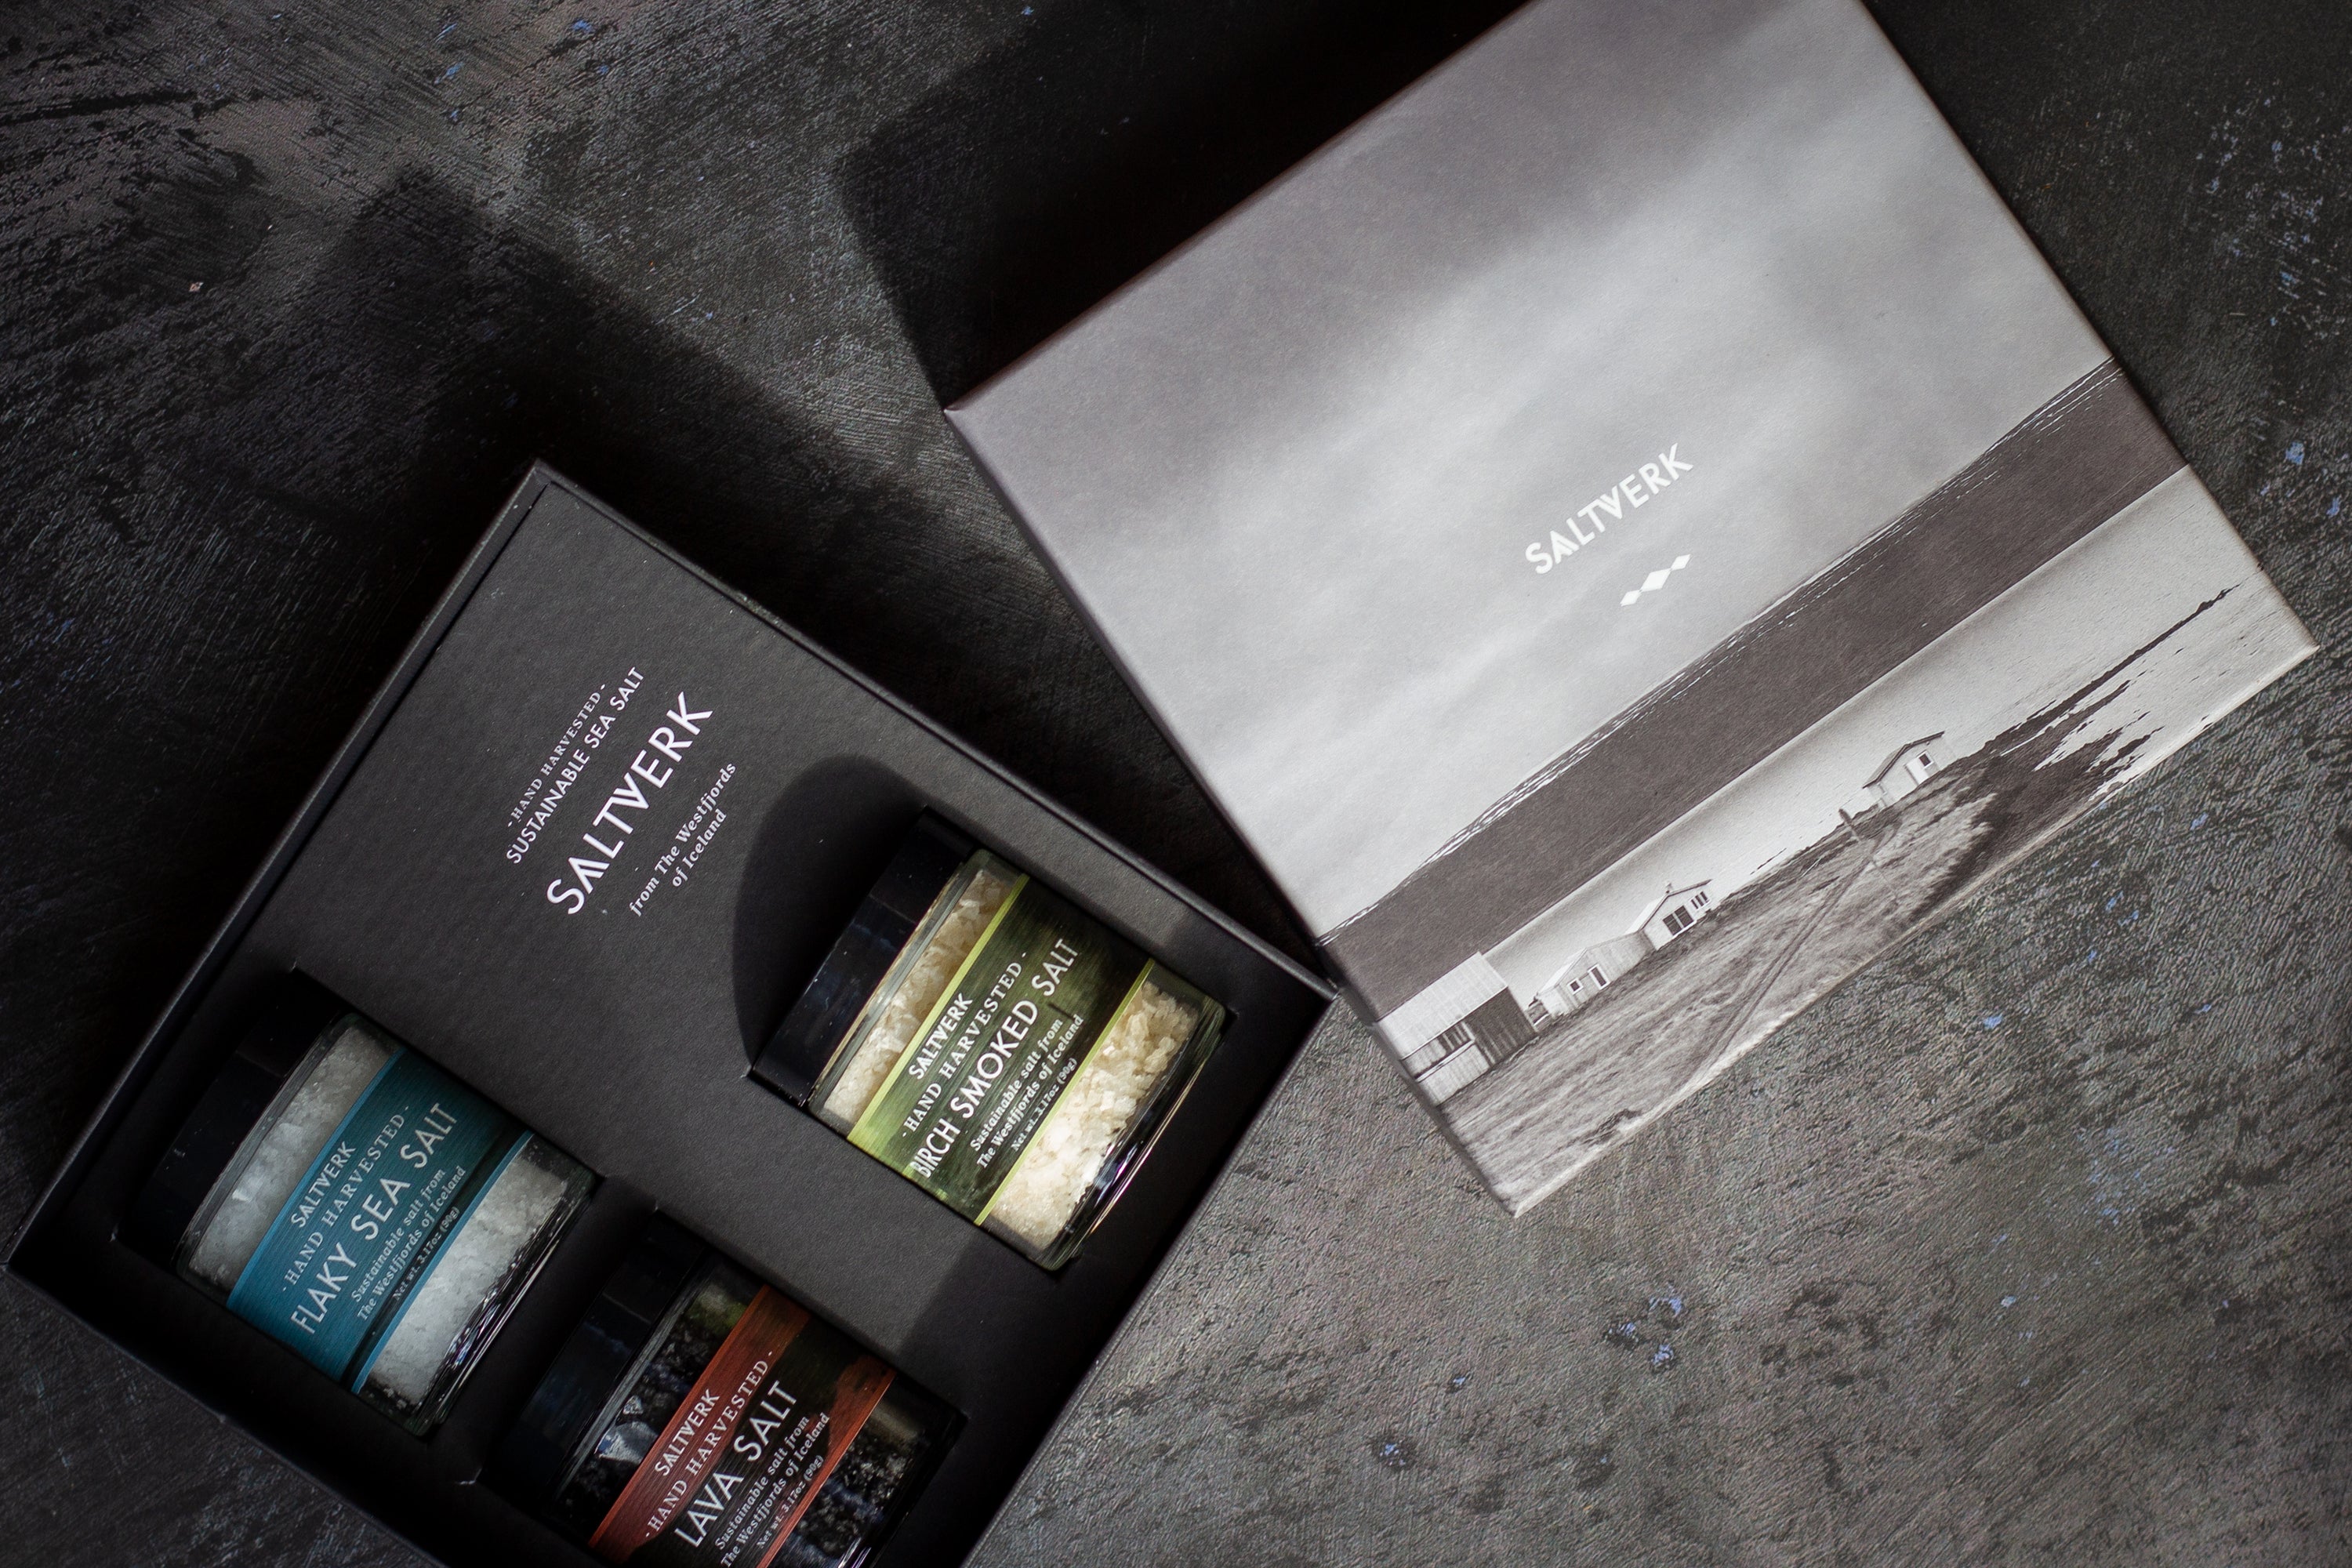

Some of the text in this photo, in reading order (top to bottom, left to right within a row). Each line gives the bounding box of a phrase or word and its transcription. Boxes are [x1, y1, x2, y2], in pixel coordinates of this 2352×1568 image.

[1525, 442, 1694, 575] SALTVERK
[506, 666, 644, 864] SUSTAINABLE SEA SALT
[546, 691, 713, 914] SALTVERK
[628, 762, 736, 917] from The Westfjords
[671, 808, 727, 887] of Iceland
[907, 992, 973, 1080] SALTVERK
[908, 938, 1078, 1178] BIRCH SMOKED SALT
[969, 1018, 1063, 1152] Sustainable salt from
[975, 1013, 1084, 1168] The Westfjords of Iceland
[1010, 1131, 1027, 1152] Net
[1055, 1057, 1077, 1084] (90g)
[289, 1140, 356, 1228] SALTVERK
[290, 1102, 456, 1334] FLAKY SEA SALT
[350, 1168, 446, 1302] Sustainable salt from
[356, 1164, 466, 1320] The Westfjords of Iceland
[391, 1280, 408, 1301] Net
[438, 1206, 459, 1232] (90g)
[653, 1388, 720, 1476] SALTVERK
[673, 1379, 797, 1547] LAVA SALT
[714, 1416, 810, 1550] Sustainable salt from
[720, 1411, 830, 1567] The Westfjords of Iceland
[756, 1529, 772, 1549] Net
[802, 1454, 824, 1482] (90g)
